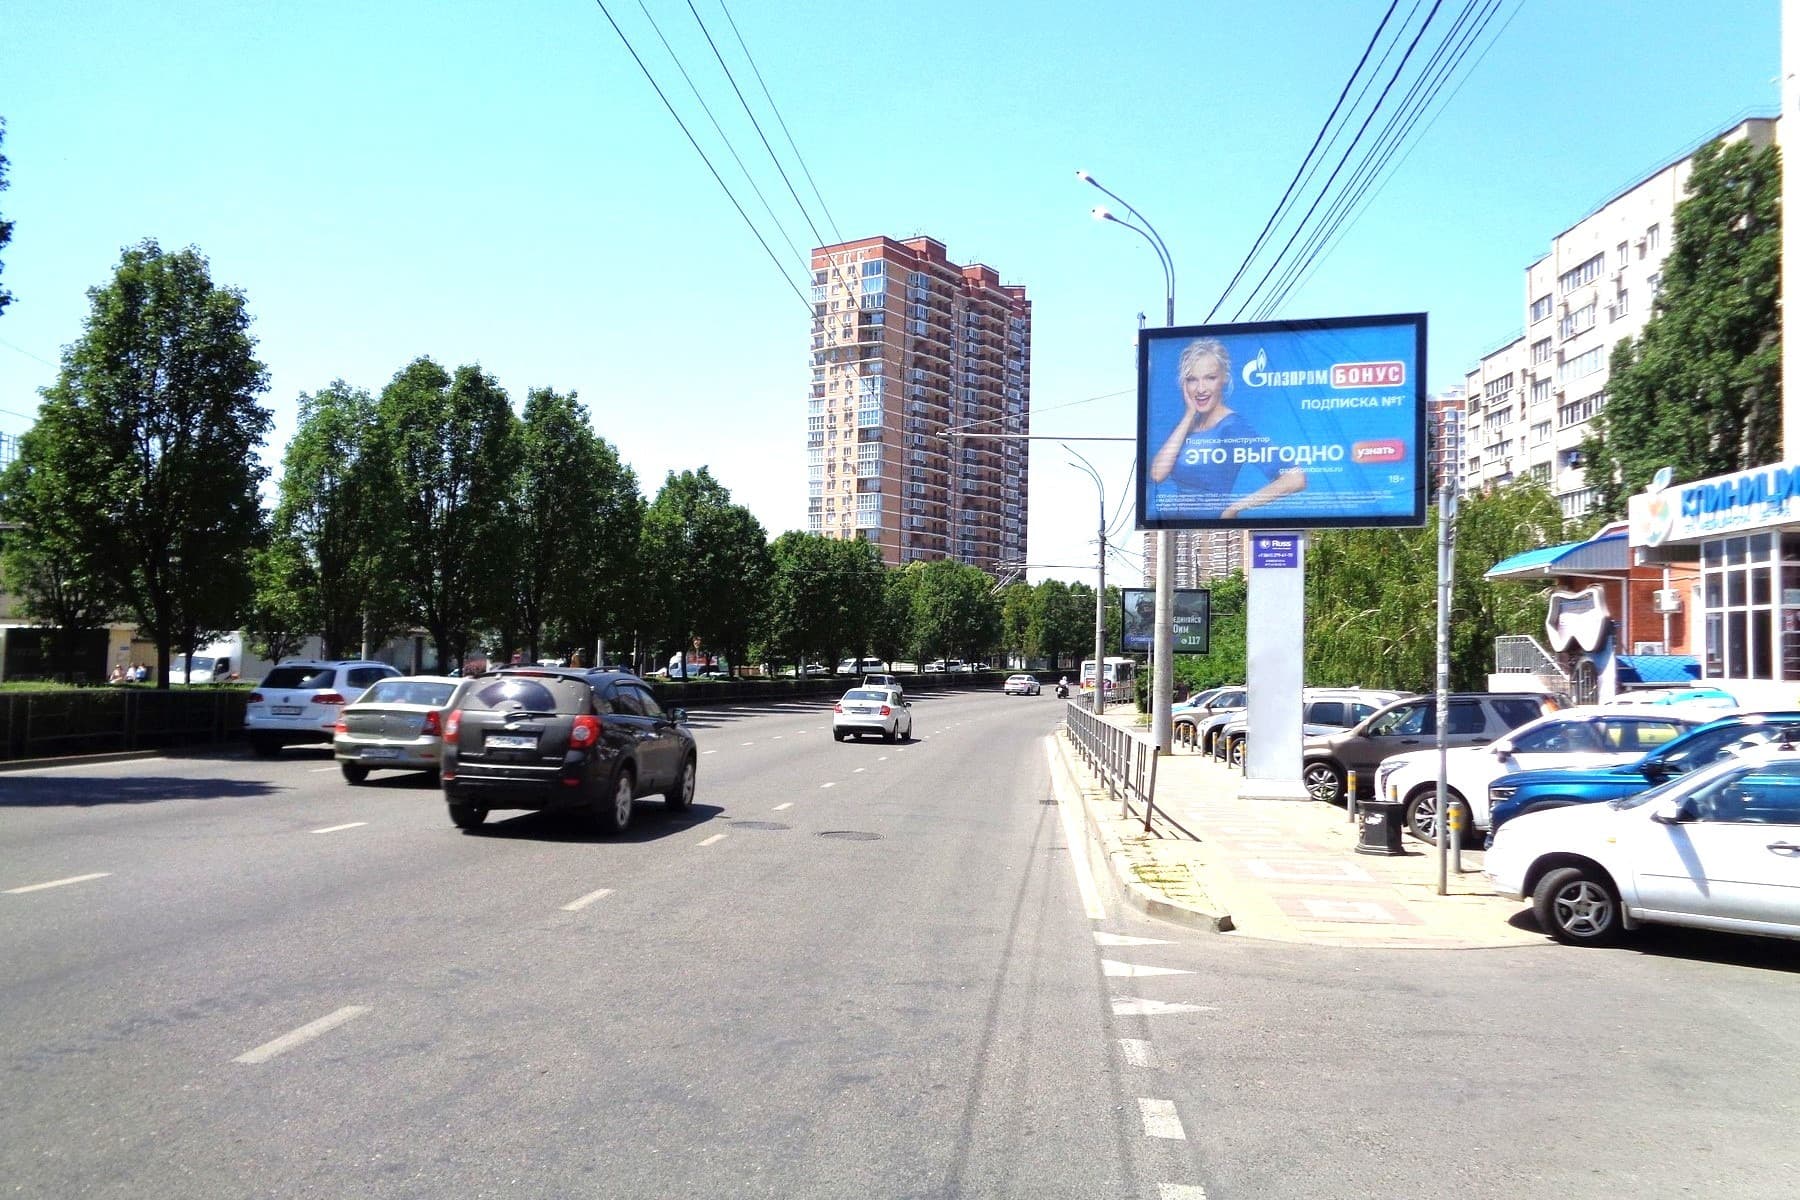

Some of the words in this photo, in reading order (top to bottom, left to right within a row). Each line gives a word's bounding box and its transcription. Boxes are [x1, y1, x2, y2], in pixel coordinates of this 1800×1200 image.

[1267, 369, 1328, 387] ГАЗПРОМ
[1335, 366, 1400, 384] БОНУС
[1301, 397, 1378, 411] ПОДПИСКА
[1185, 436, 1271, 446] Подписка-конструктор
[1185, 448, 1227, 464] ЭТО
[1233, 444, 1344, 465] ВЫГОДНО
[1358, 446, 1395, 458] узнать
[1271, 539, 1292, 547] Russ
[1188, 636, 1201, 645] 117
